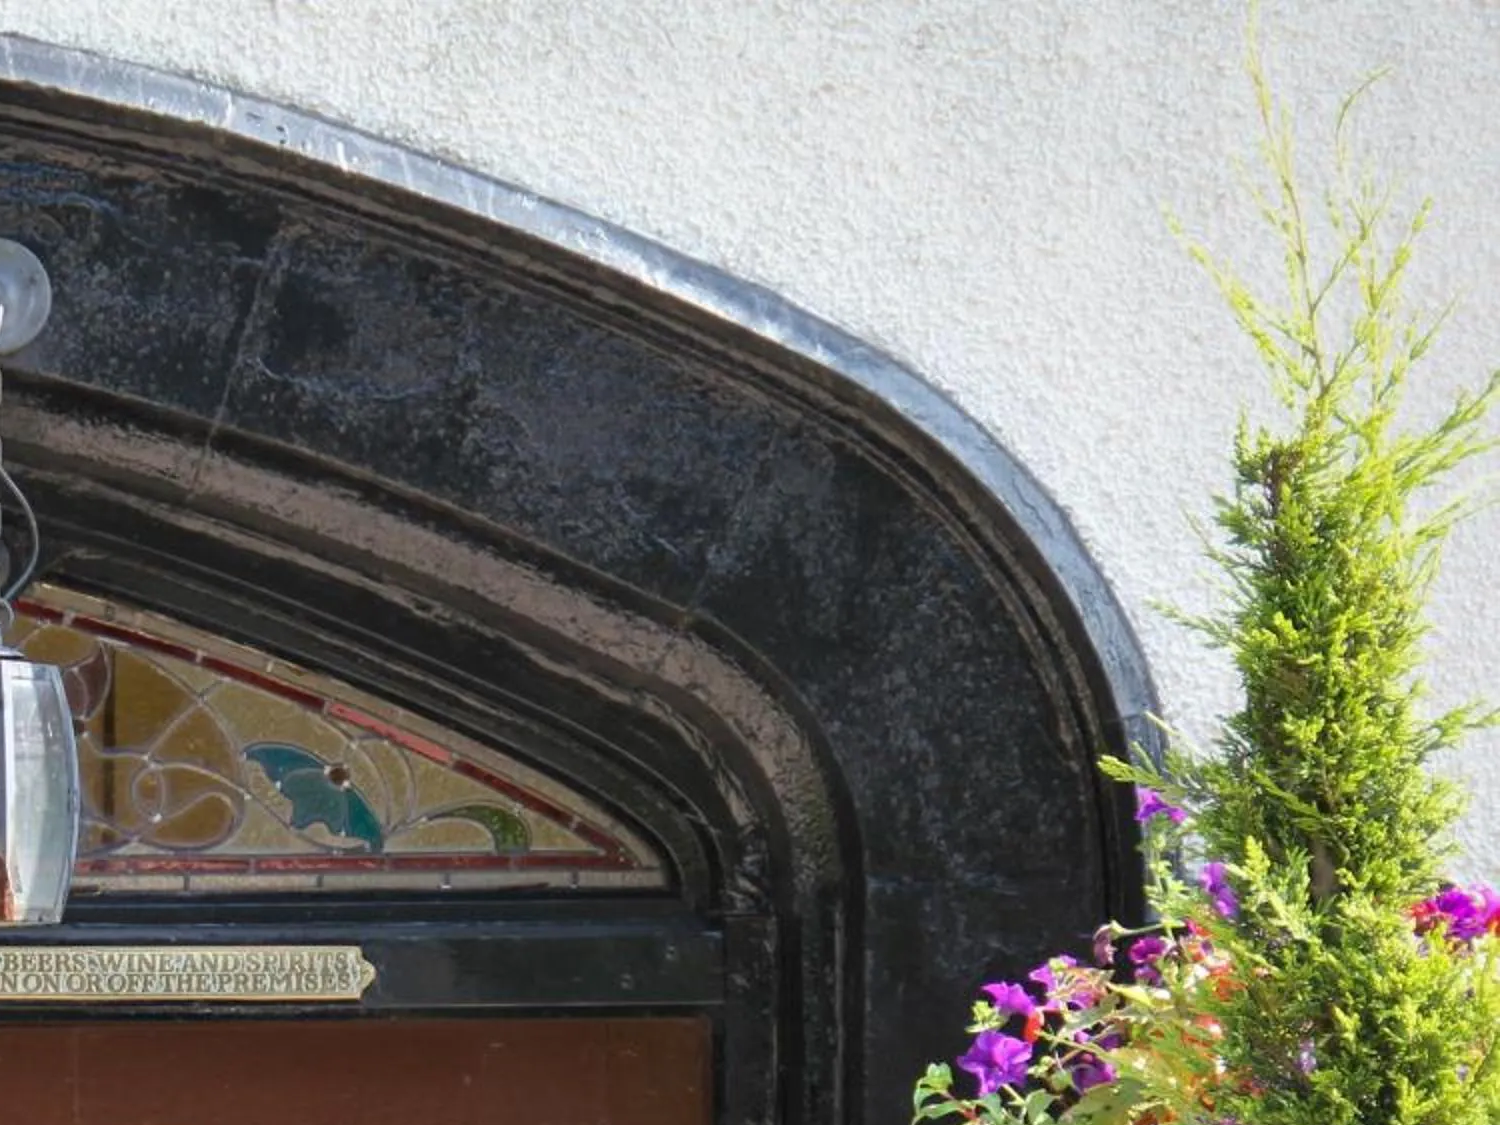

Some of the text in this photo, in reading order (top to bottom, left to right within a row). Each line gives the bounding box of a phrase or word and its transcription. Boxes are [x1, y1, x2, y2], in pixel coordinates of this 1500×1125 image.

[178, 953, 238, 972] AND
[243, 953, 348, 972] SPIRITS
[23, 973, 60, 993] ON
[66, 973, 104, 993] OR
[108, 973, 156, 993] OFF
[160, 973, 211, 993] THE
[218, 973, 350, 993] PREMISES
